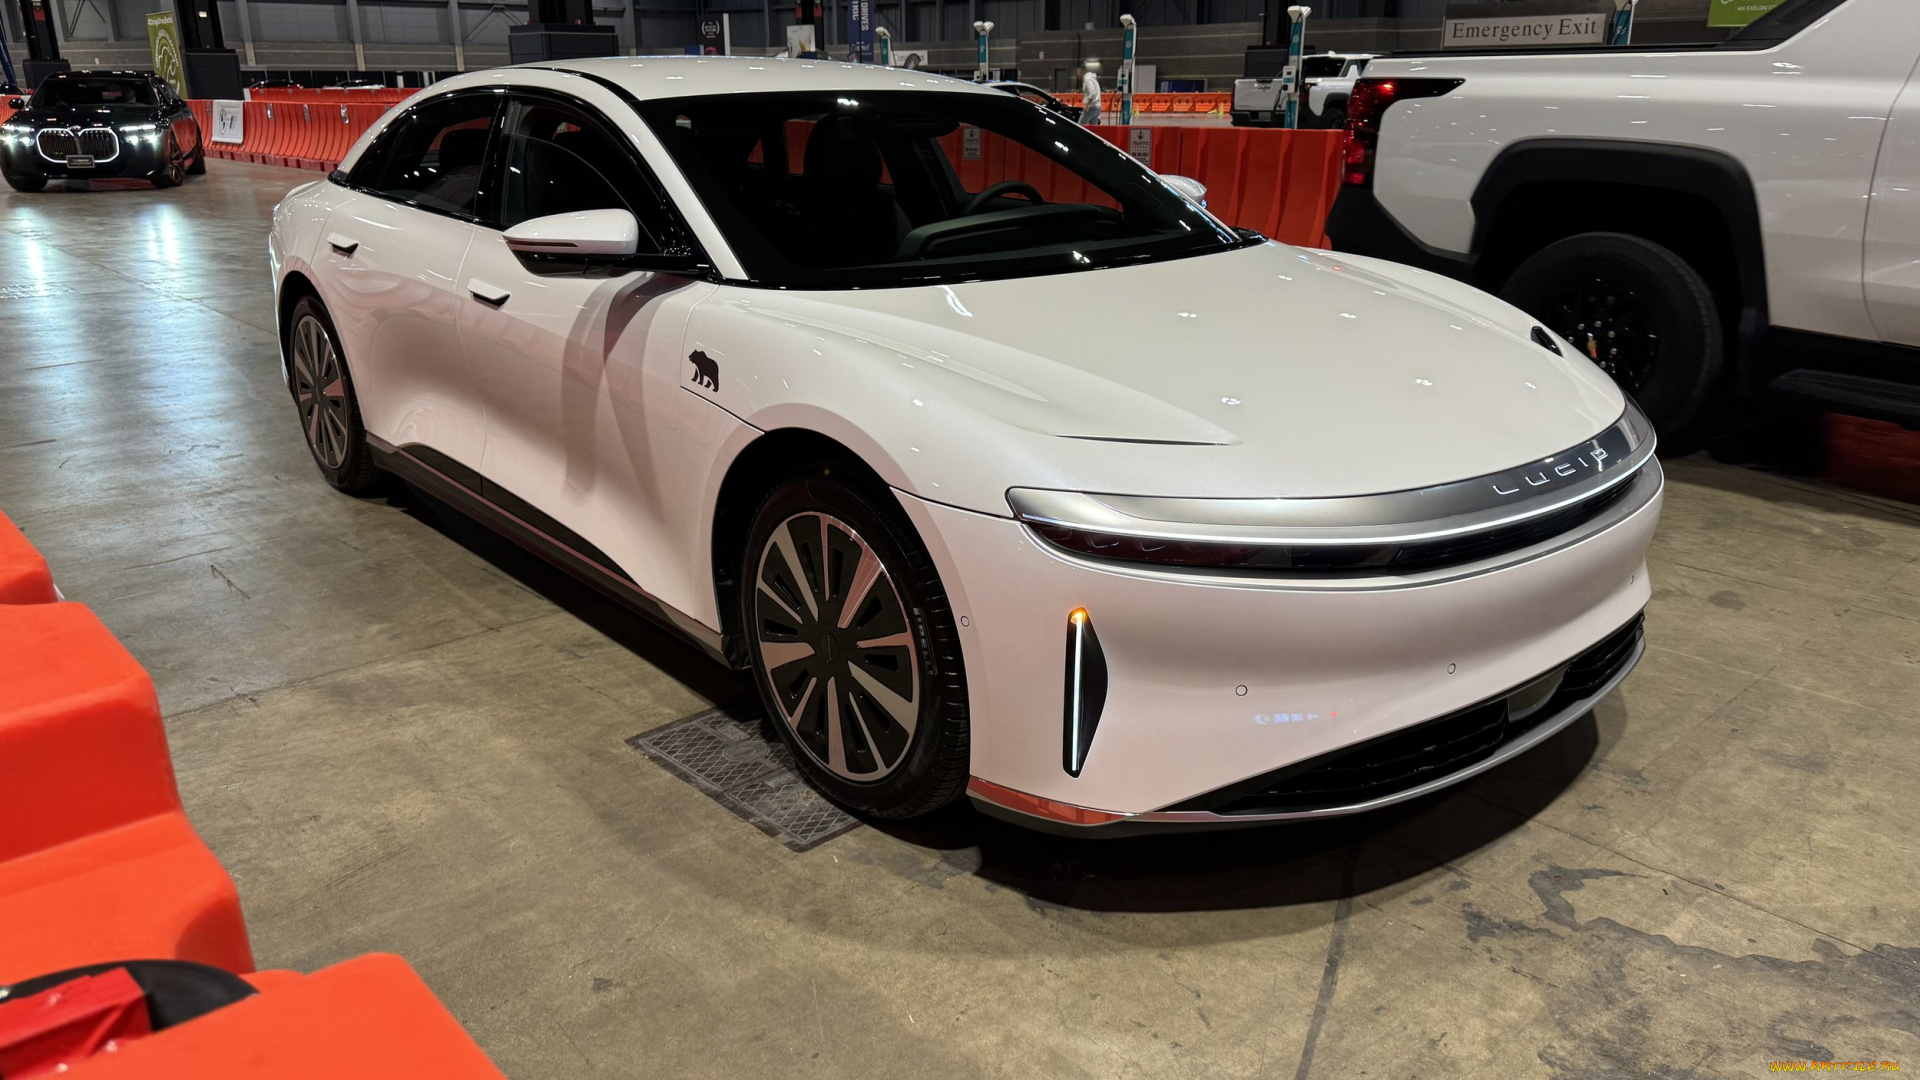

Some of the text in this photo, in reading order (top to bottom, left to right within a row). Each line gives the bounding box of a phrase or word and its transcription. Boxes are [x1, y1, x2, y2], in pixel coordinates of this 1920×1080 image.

[861, 2, 869, 31] DRIVES
[1452, 22, 1553, 42] Emergency
[1558, 17, 1598, 35] Exit
[1492, 447, 1609, 495] LUCID
